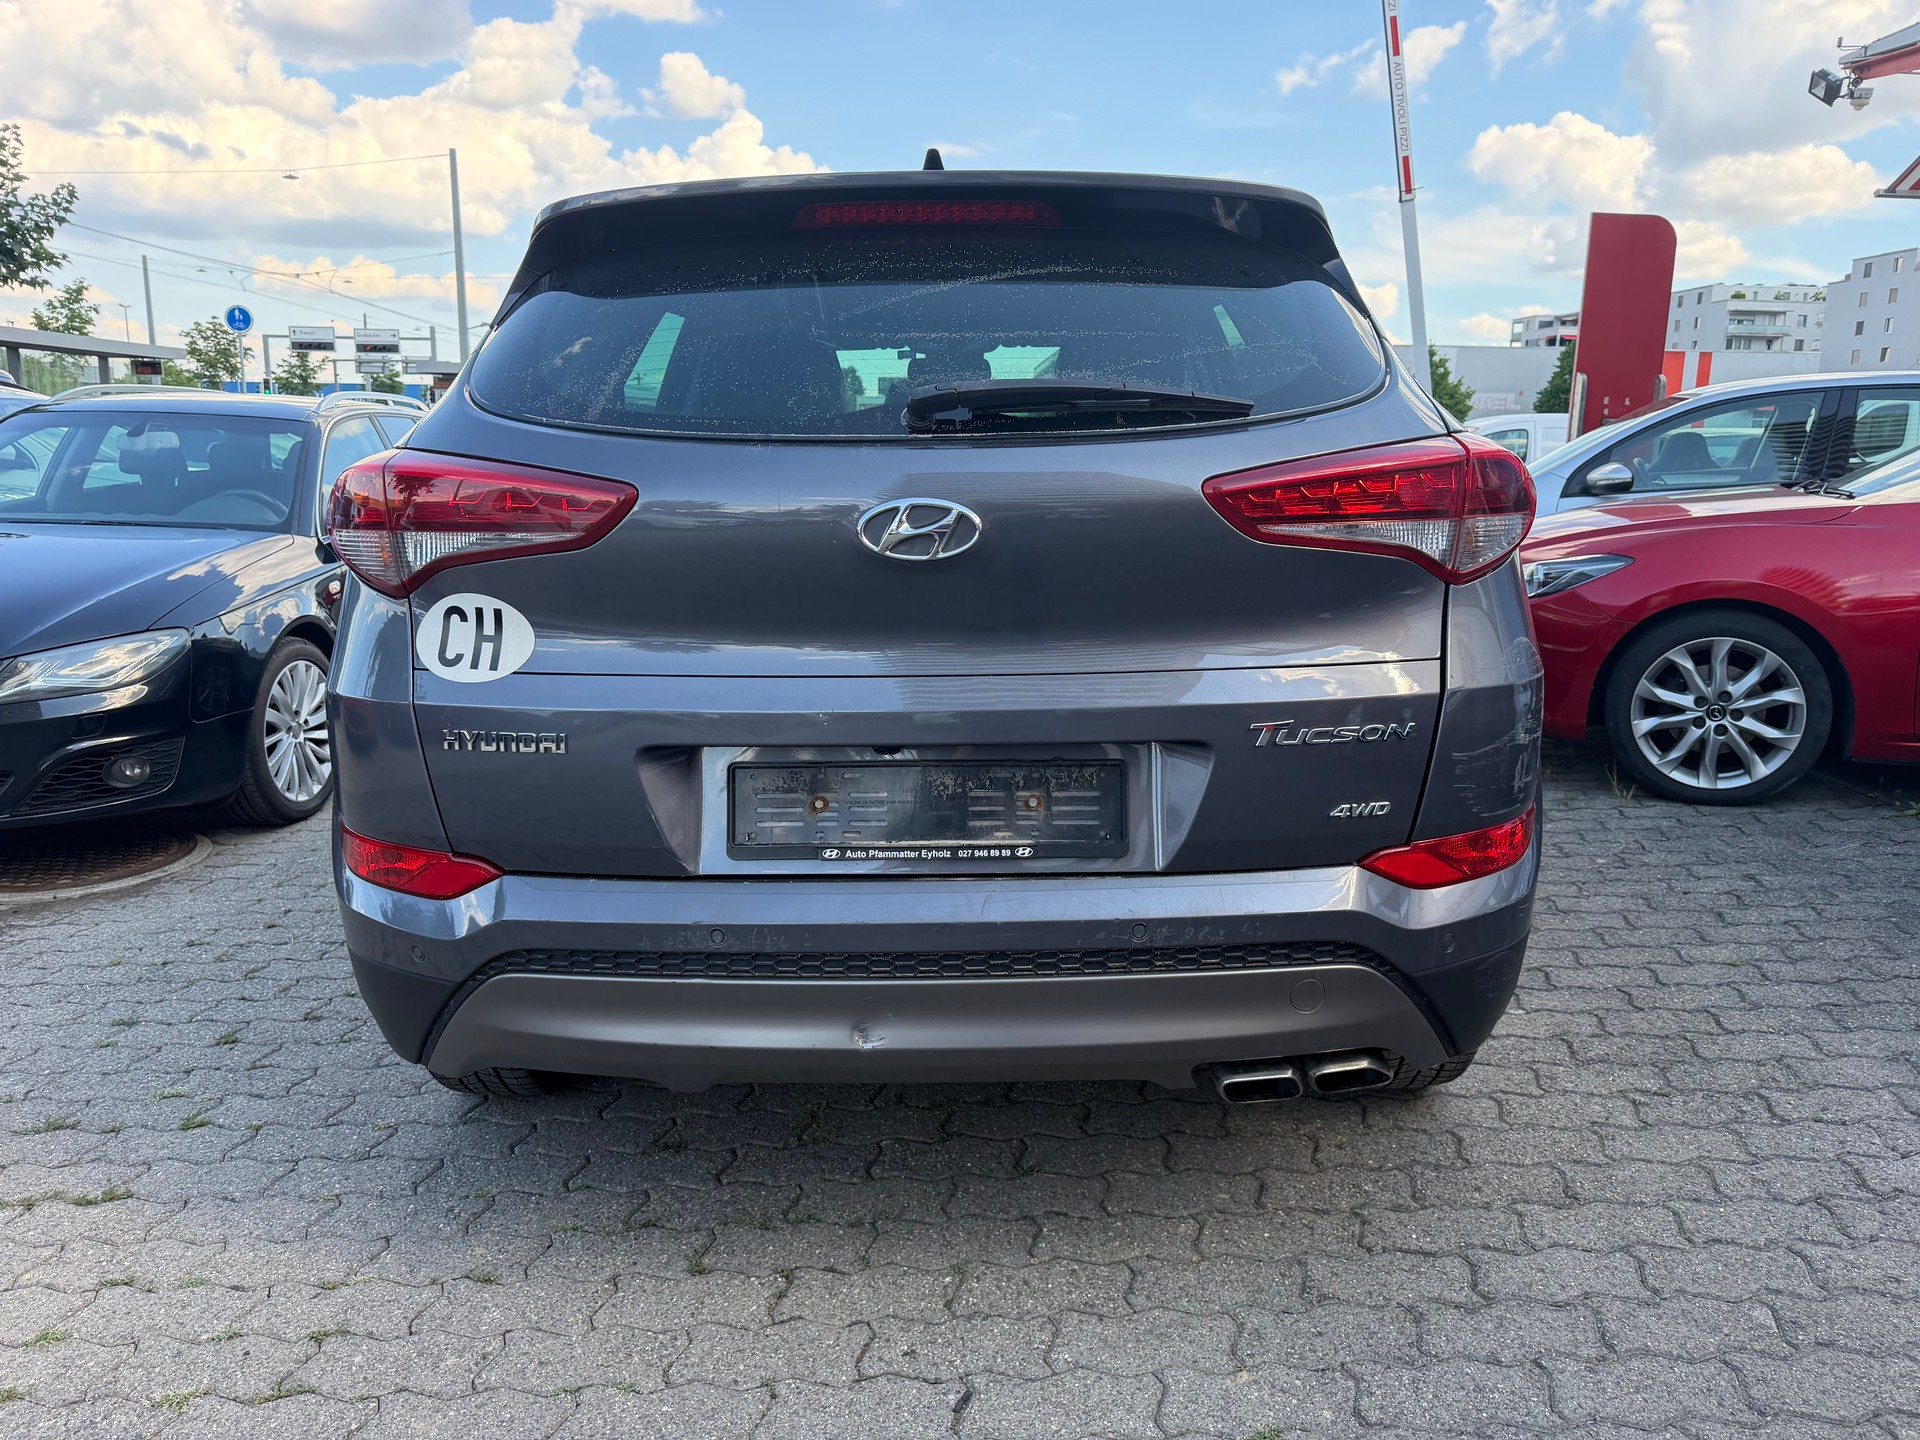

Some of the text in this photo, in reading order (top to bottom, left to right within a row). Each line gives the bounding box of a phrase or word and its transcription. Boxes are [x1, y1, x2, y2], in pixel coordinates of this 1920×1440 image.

[1393, 61, 1409, 152] AUTO TIVOLI PIZZI
[438, 605, 503, 672] CH
[442, 729, 569, 754] HYUNDAI
[1250, 719, 1416, 748] TUCSON
[1329, 801, 1392, 818] 4WD
[845, 848, 1011, 860] Auto Pfammatter Eyholz 027 946 89 89
